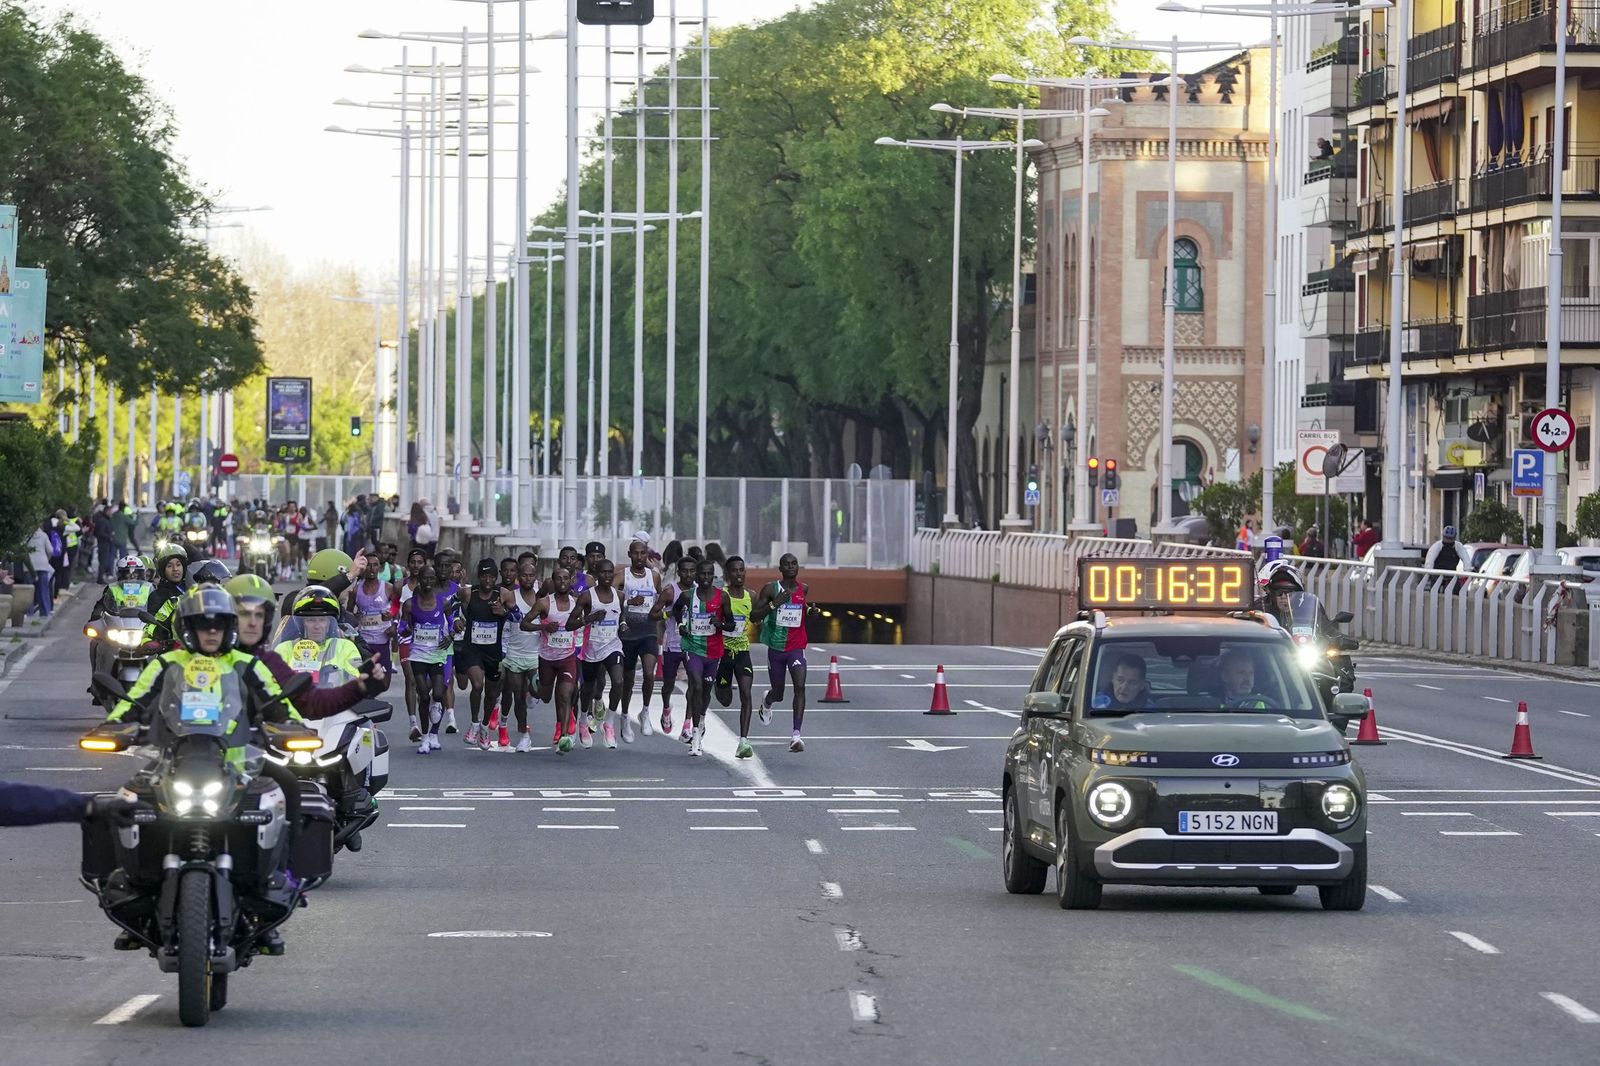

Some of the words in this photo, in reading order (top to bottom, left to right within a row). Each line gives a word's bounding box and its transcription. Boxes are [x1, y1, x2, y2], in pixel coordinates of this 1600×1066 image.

[1517, 453, 1536, 478] P
[1089, 565, 1242, 603] 00:16:32
[1192, 814, 1235, 830] 5152
[1241, 814, 1274, 830] NGN
